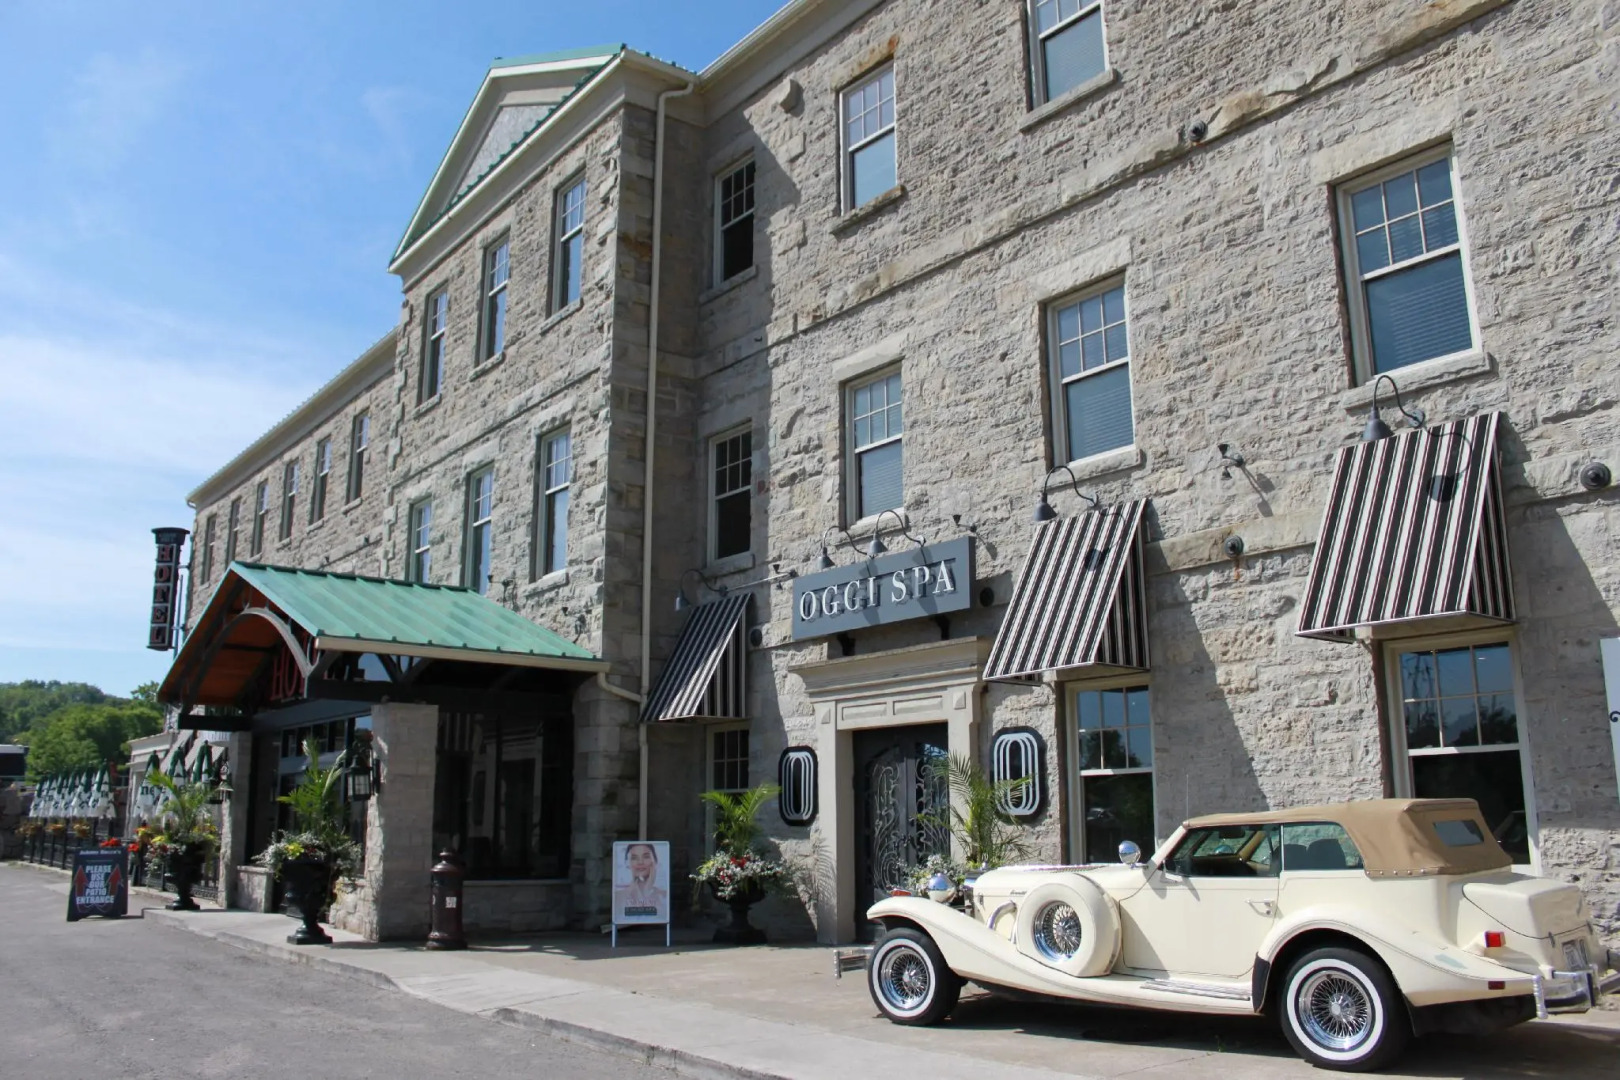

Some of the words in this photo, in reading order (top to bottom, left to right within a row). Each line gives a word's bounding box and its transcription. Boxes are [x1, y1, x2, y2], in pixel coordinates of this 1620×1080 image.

[151, 544, 173, 644] HOTEL
[800, 576, 876, 620] OGGI
[891, 560, 954, 603] SPA
[85, 864, 112, 873] PLEASE
[91, 873, 105, 881] USE
[88, 880, 105, 889] OUR
[85, 888, 107, 896] PATIO
[76, 895, 115, 905] ENTRANCE
